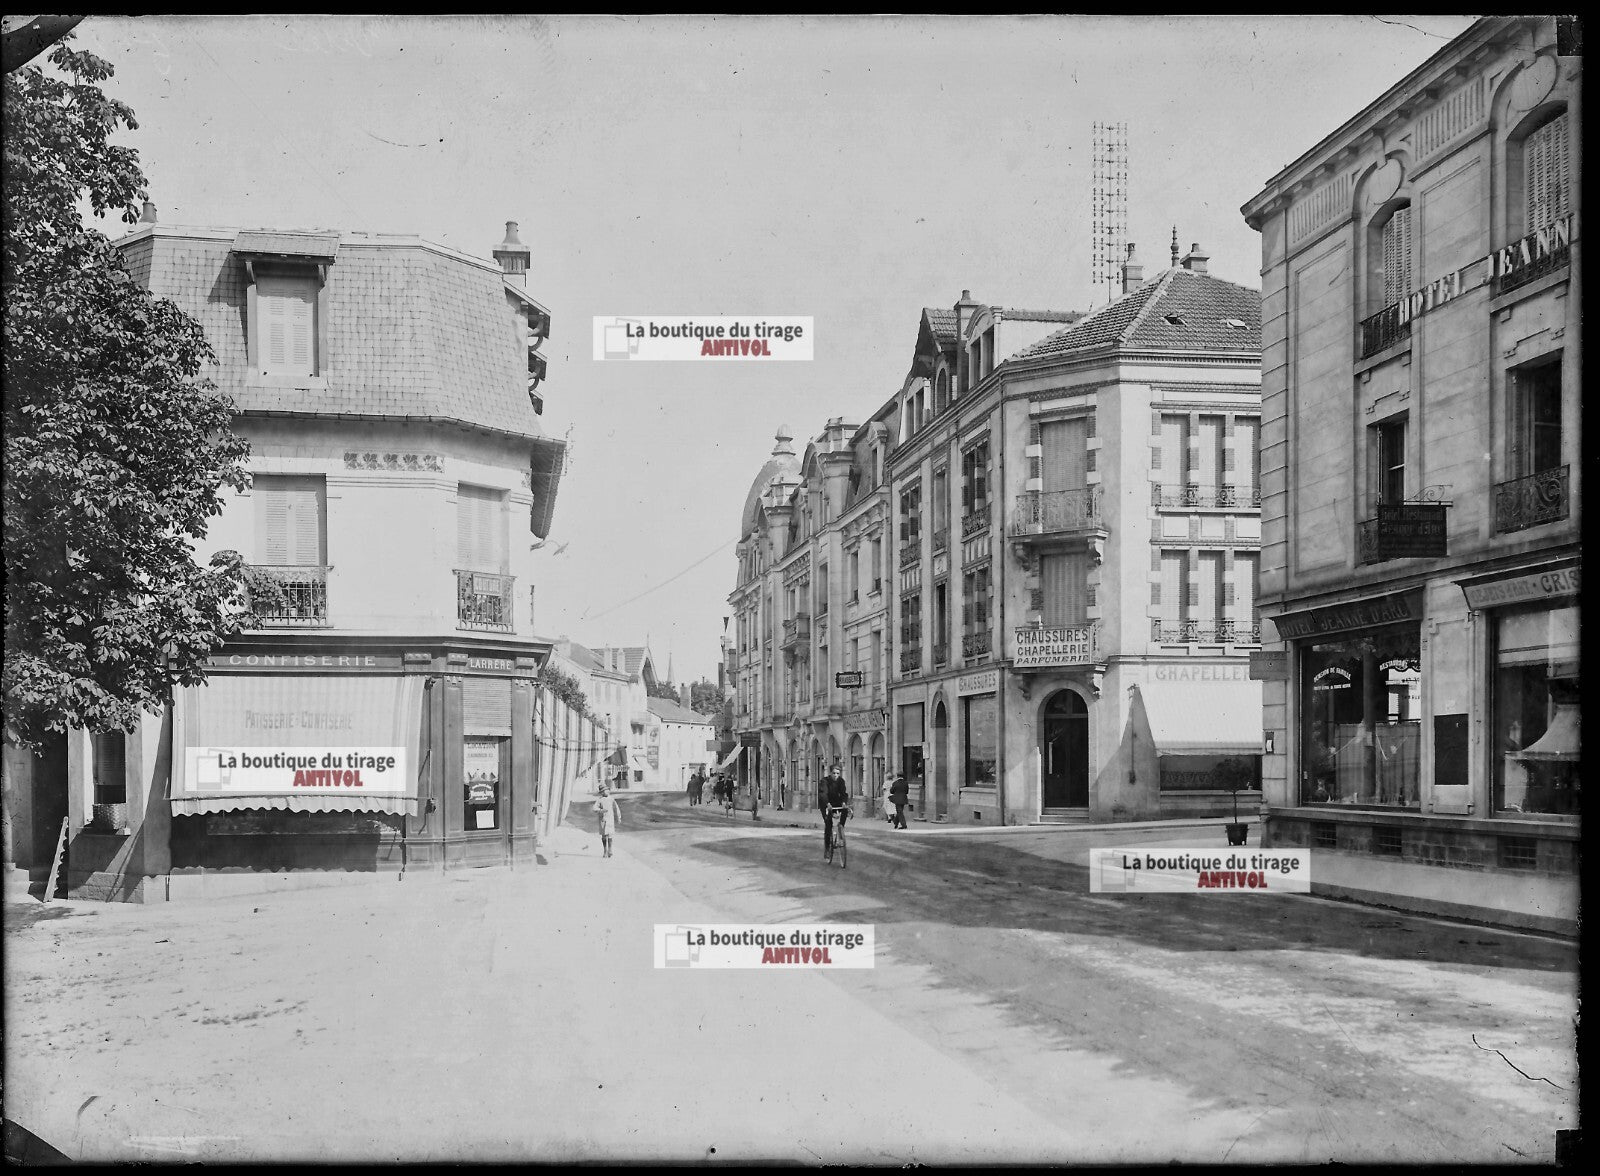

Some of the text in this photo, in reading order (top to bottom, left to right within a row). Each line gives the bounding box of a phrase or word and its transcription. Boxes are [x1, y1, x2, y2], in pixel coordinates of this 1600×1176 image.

[1399, 271, 1466, 326] HOTEL
[1321, 608, 1366, 630] JEANNE
[1016, 629, 1088, 644] CHAUSSURES
[1017, 643, 1088, 656] CHAPELLERIE
[229, 655, 376, 666] CONFISERIE
[1016, 655, 1089, 665] PARFUMERIE
[959, 672, 995, 692] CHAUSSURES
